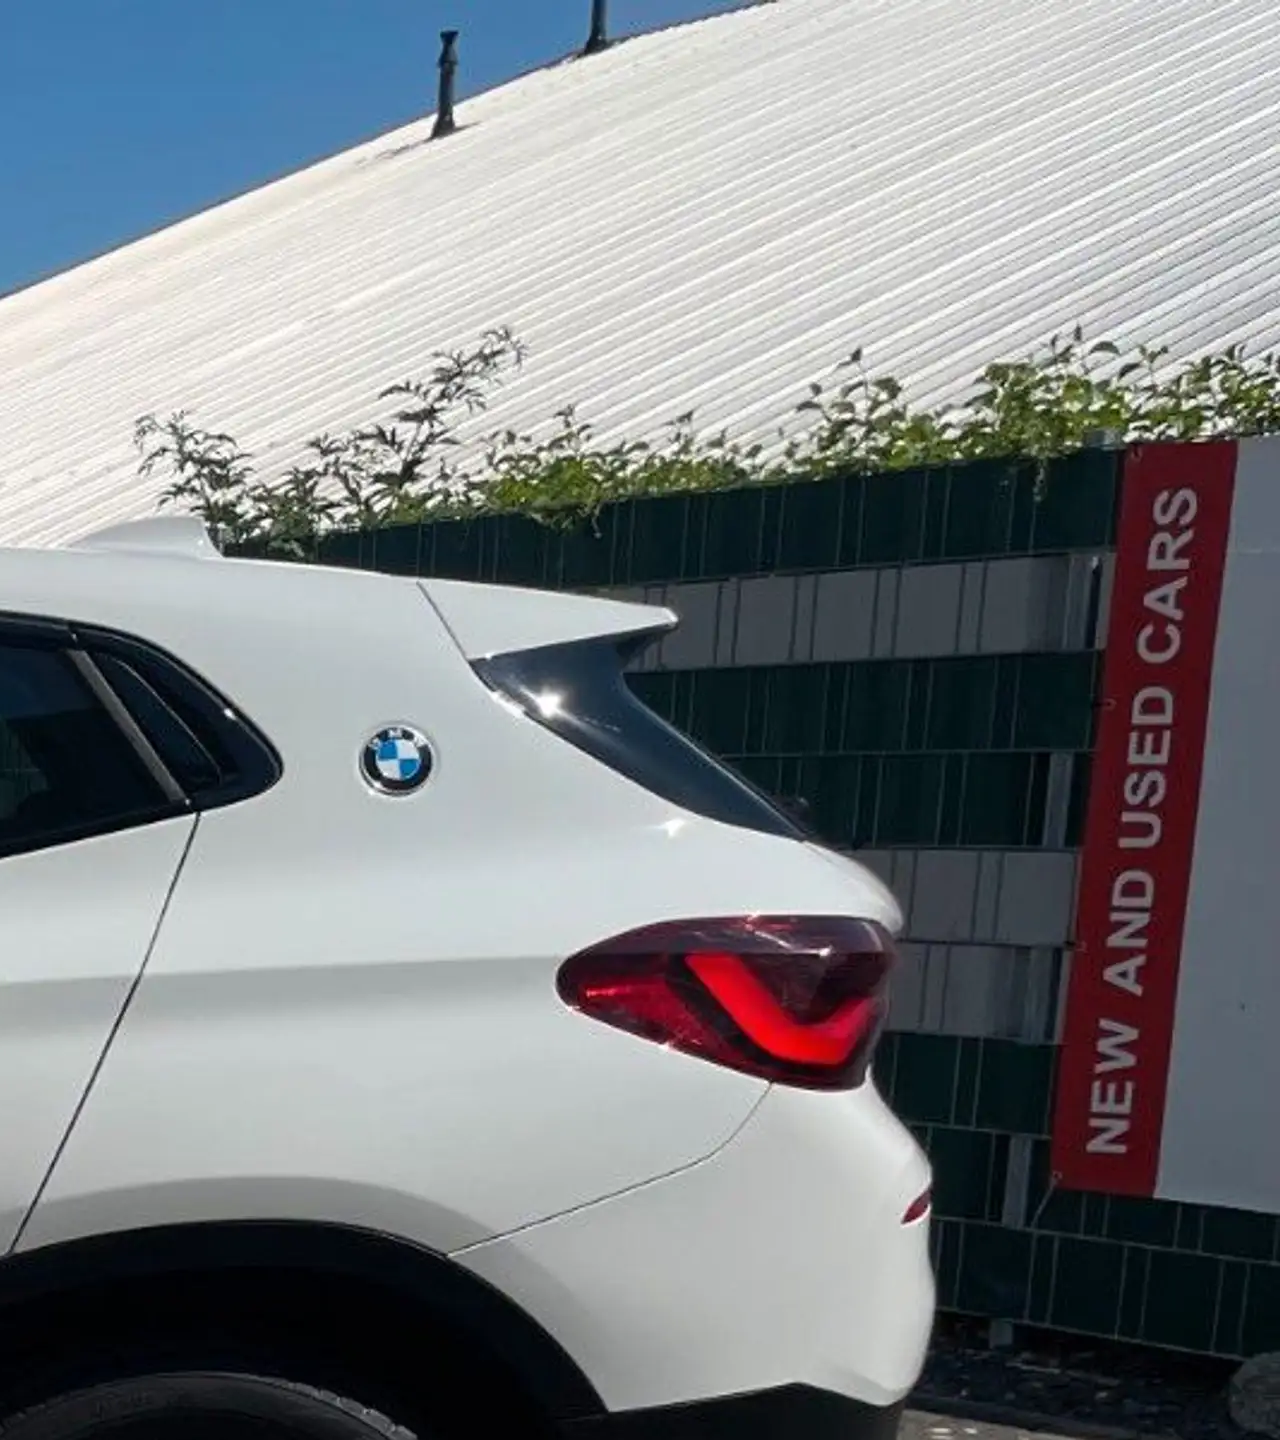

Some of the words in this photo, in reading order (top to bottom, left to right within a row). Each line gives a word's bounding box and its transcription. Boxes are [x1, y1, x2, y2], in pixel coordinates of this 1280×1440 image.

[1137, 489, 1197, 663] CARS
[1119, 686, 1173, 848] USED
[1103, 870, 1154, 996] AND
[1086, 1019, 1139, 1153] NEW
